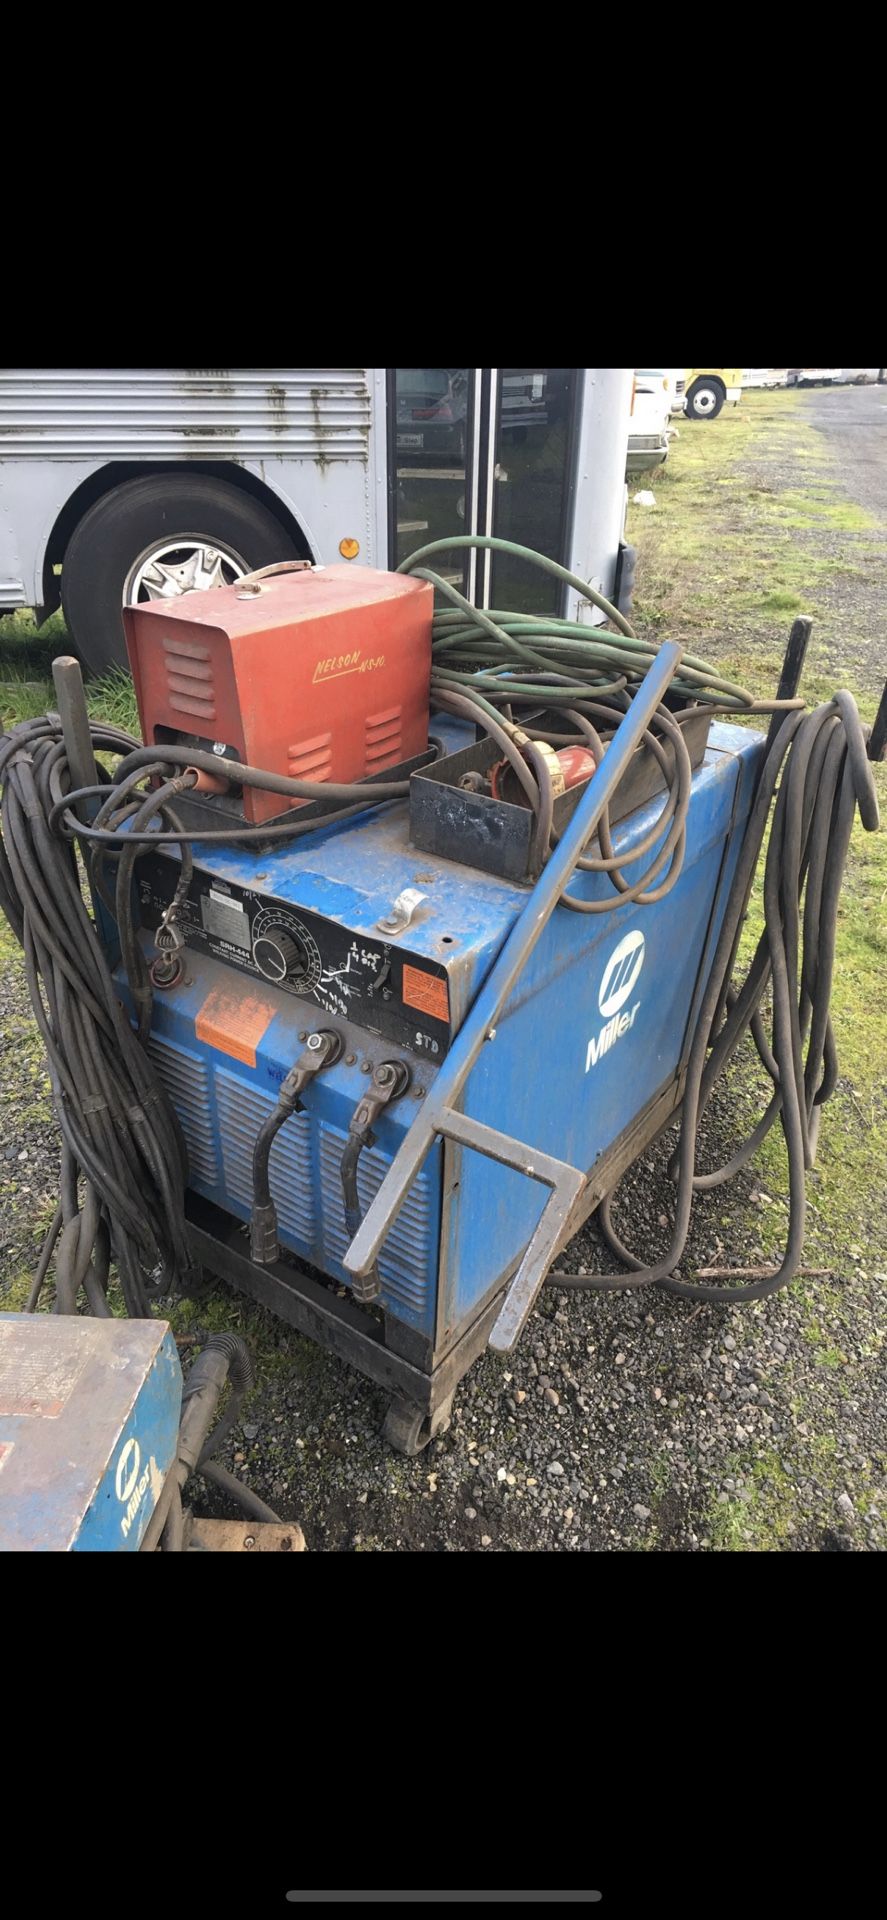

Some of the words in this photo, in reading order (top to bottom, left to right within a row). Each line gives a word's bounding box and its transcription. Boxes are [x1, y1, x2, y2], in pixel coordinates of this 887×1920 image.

[316, 650, 361, 675] NELSON
[415, 1031, 439, 1054] STD
[585, 1001, 641, 1074] Miller
[121, 1463, 150, 1537] Miller
